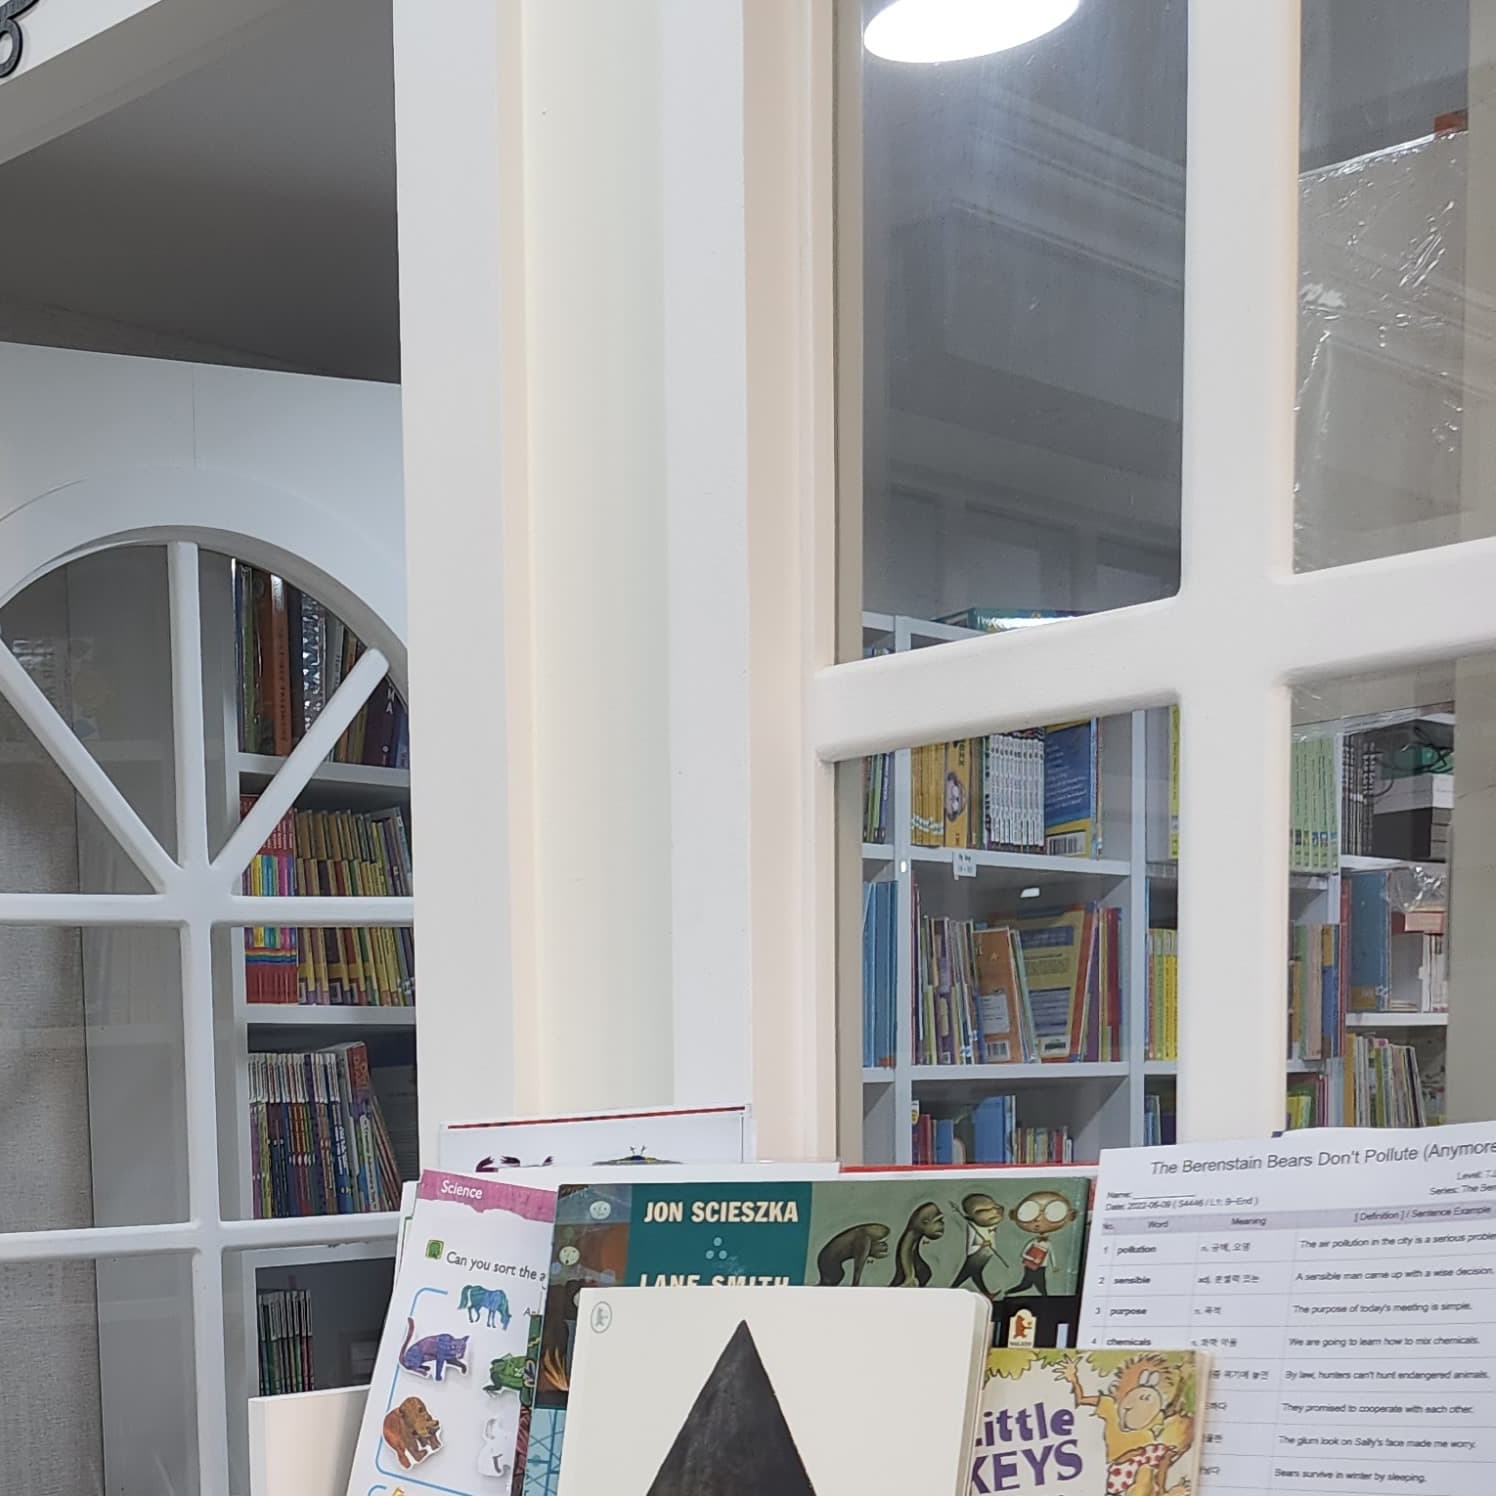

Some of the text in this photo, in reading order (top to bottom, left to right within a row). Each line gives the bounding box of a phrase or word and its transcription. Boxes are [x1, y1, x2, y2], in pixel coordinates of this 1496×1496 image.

[1151, 1160, 1177, 1176] The
[1183, 1155, 1262, 1174] Berenstain
[1267, 1151, 1313, 1170] Bears
[1318, 1149, 1360, 1168] Don't
[1364, 1146, 1418, 1165] Pollute
[440, 1179, 483, 1200] Science
[643, 1201, 799, 1223] JON SCIESZKA
[1231, 1216, 1267, 1227] Meaning
[1117, 1245, 1156, 1256] pollution
[446, 1251, 537, 1280] Can you sort the
[1114, 1275, 1151, 1284] sensible
[1110, 1307, 1147, 1317] purpose
[1311, 1305, 1347, 1316] purpose
[1106, 1337, 1152, 1346] chemicals
[974, 1401, 1075, 1448] ittle
